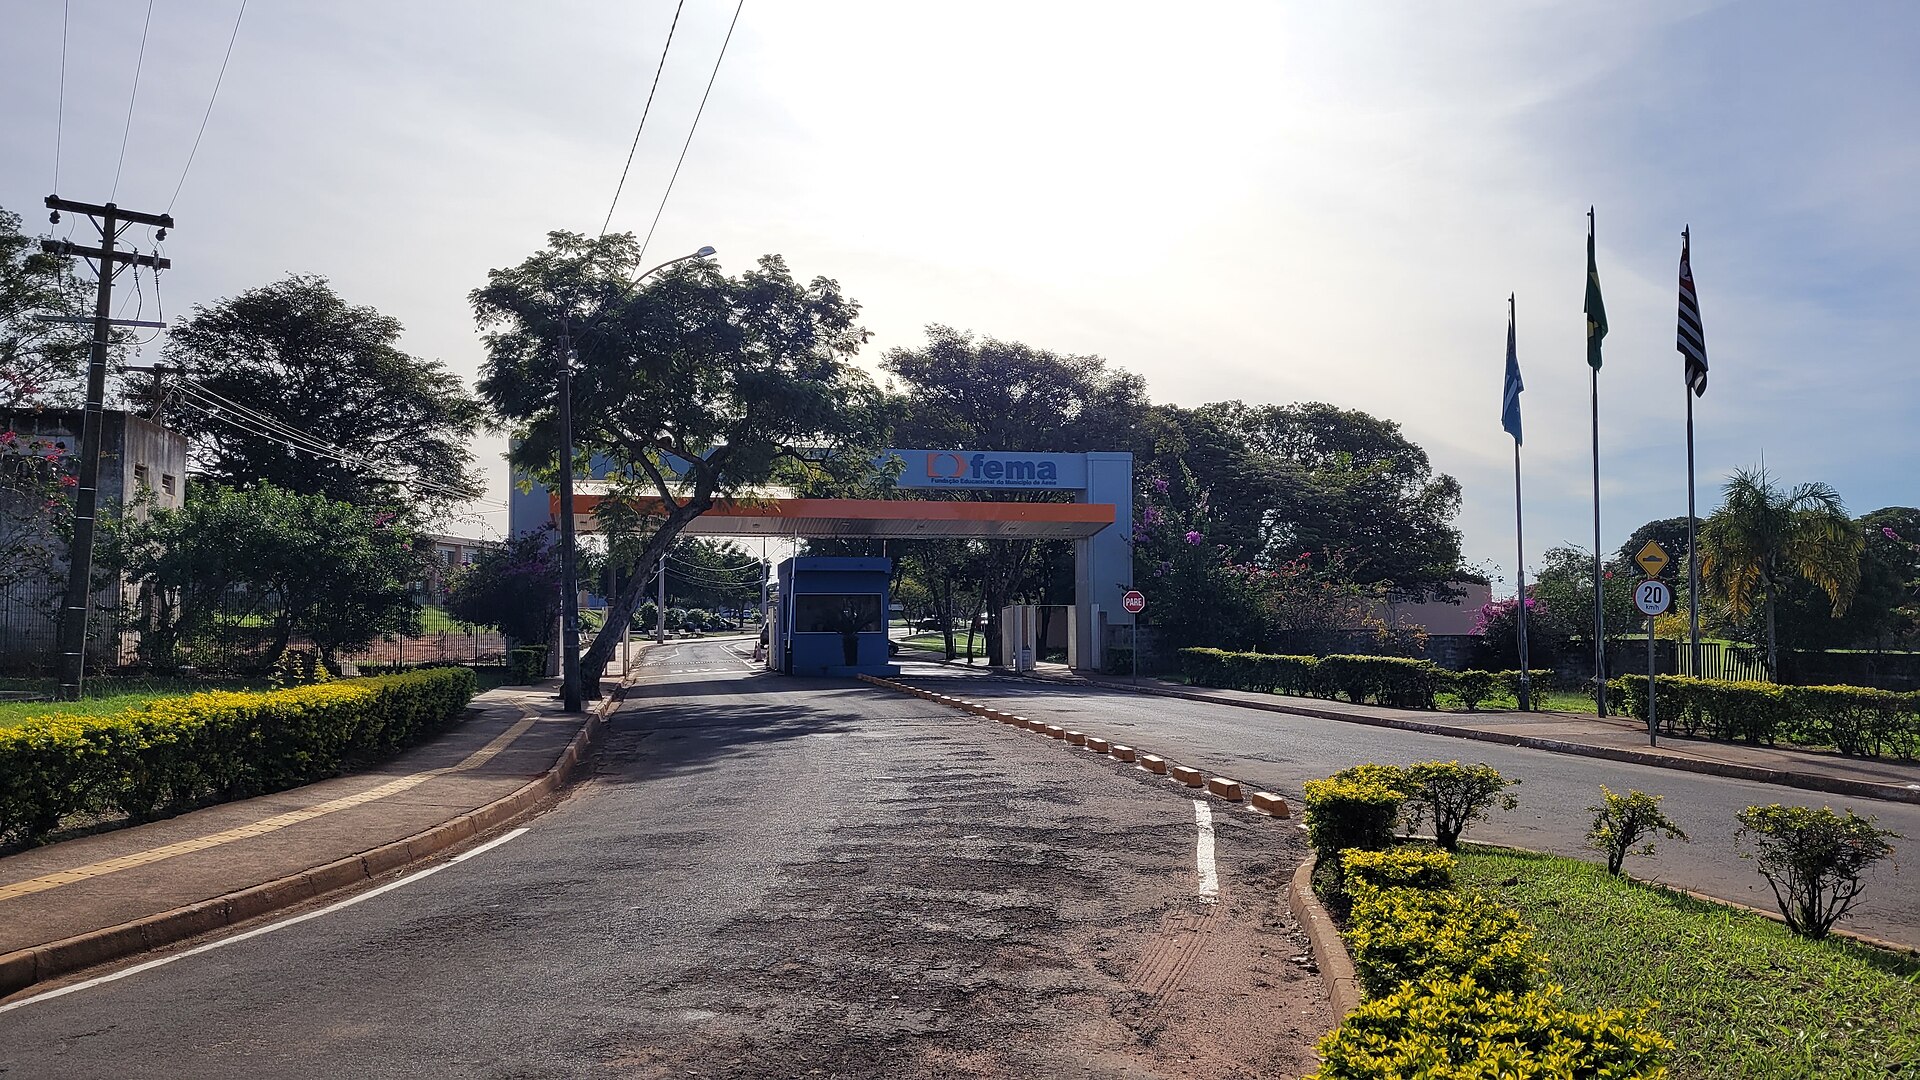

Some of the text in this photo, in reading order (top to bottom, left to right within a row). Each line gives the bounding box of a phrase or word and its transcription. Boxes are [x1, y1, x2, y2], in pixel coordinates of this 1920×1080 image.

[970, 454, 1057, 479] fema
[1125, 597, 1142, 606] PARE
[1644, 586, 1662, 604] 20
